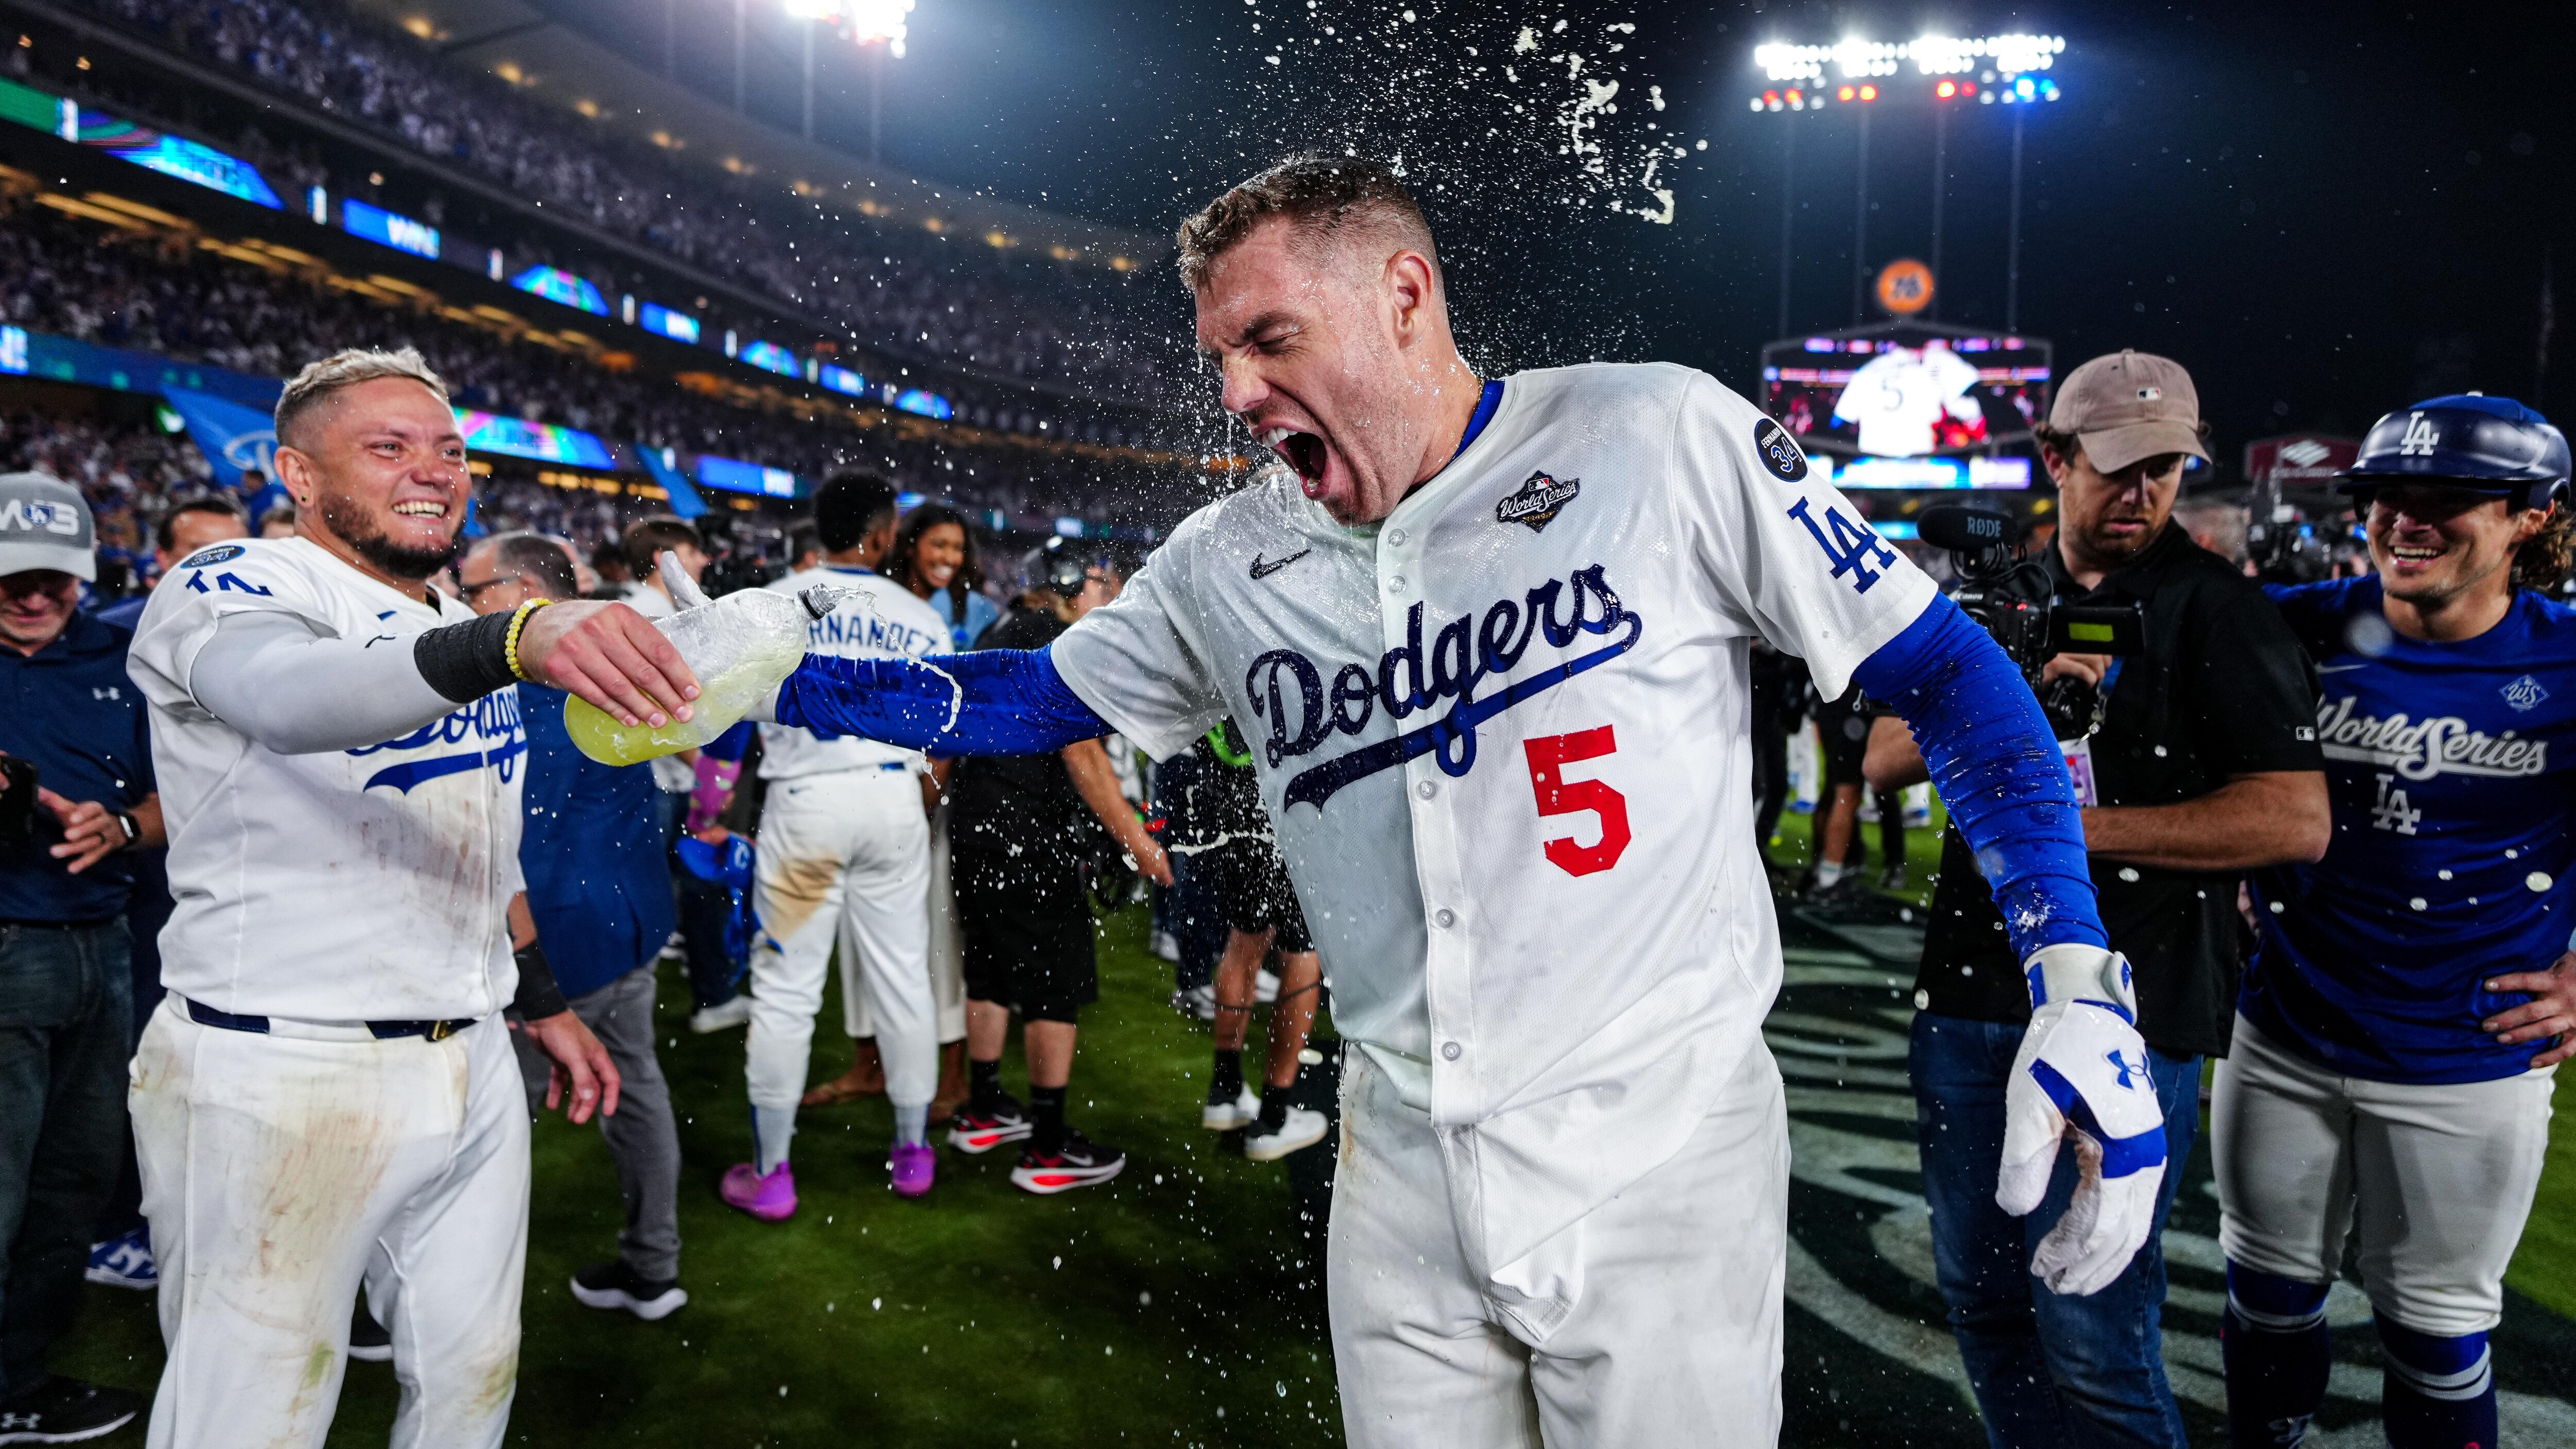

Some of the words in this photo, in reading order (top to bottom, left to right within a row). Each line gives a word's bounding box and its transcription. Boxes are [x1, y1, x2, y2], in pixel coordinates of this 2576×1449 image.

[1770, 436, 1802, 473] 34
[2400, 411, 2440, 456] LA
[1787, 496, 1897, 594] LA
[1967, 516, 2002, 538] RØDE
[1245, 564, 1642, 778] Dodgers
[1523, 725, 1632, 877] 5
[2371, 773, 2421, 836] LA
